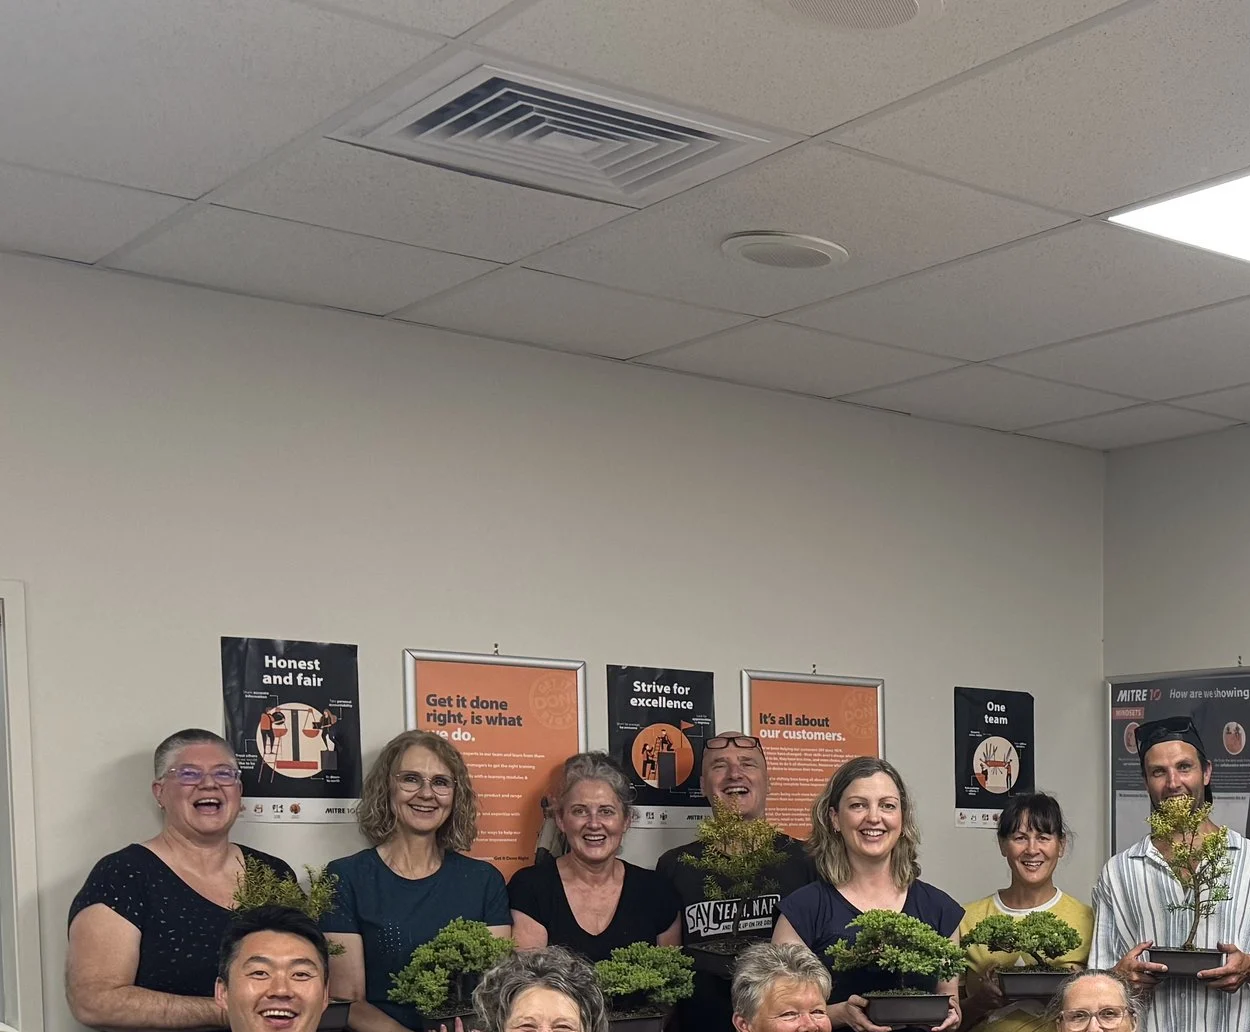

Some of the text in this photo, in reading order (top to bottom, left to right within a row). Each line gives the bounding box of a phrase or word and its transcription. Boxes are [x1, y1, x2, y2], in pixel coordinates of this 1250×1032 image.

[264, 655, 320, 670] Honest
[262, 672, 323, 686] and fair
[633, 681, 690, 695] Strive for
[1170, 689, 1188, 699] How
[1189, 690, 1202, 698] are
[1214, 687, 1250, 699] showing
[426, 694, 508, 710] Get it done
[630, 696, 693, 709] excellence
[1117, 689, 1162, 702] MITRE 10
[987, 702, 1006, 712] One
[426, 710, 523, 727] right, is what
[760, 713, 829, 727] It's all about
[984, 714, 1008, 724] team
[451, 728, 476, 742] do.
[760, 729, 846, 741] our customers.
[687, 902, 719, 932] SAY
